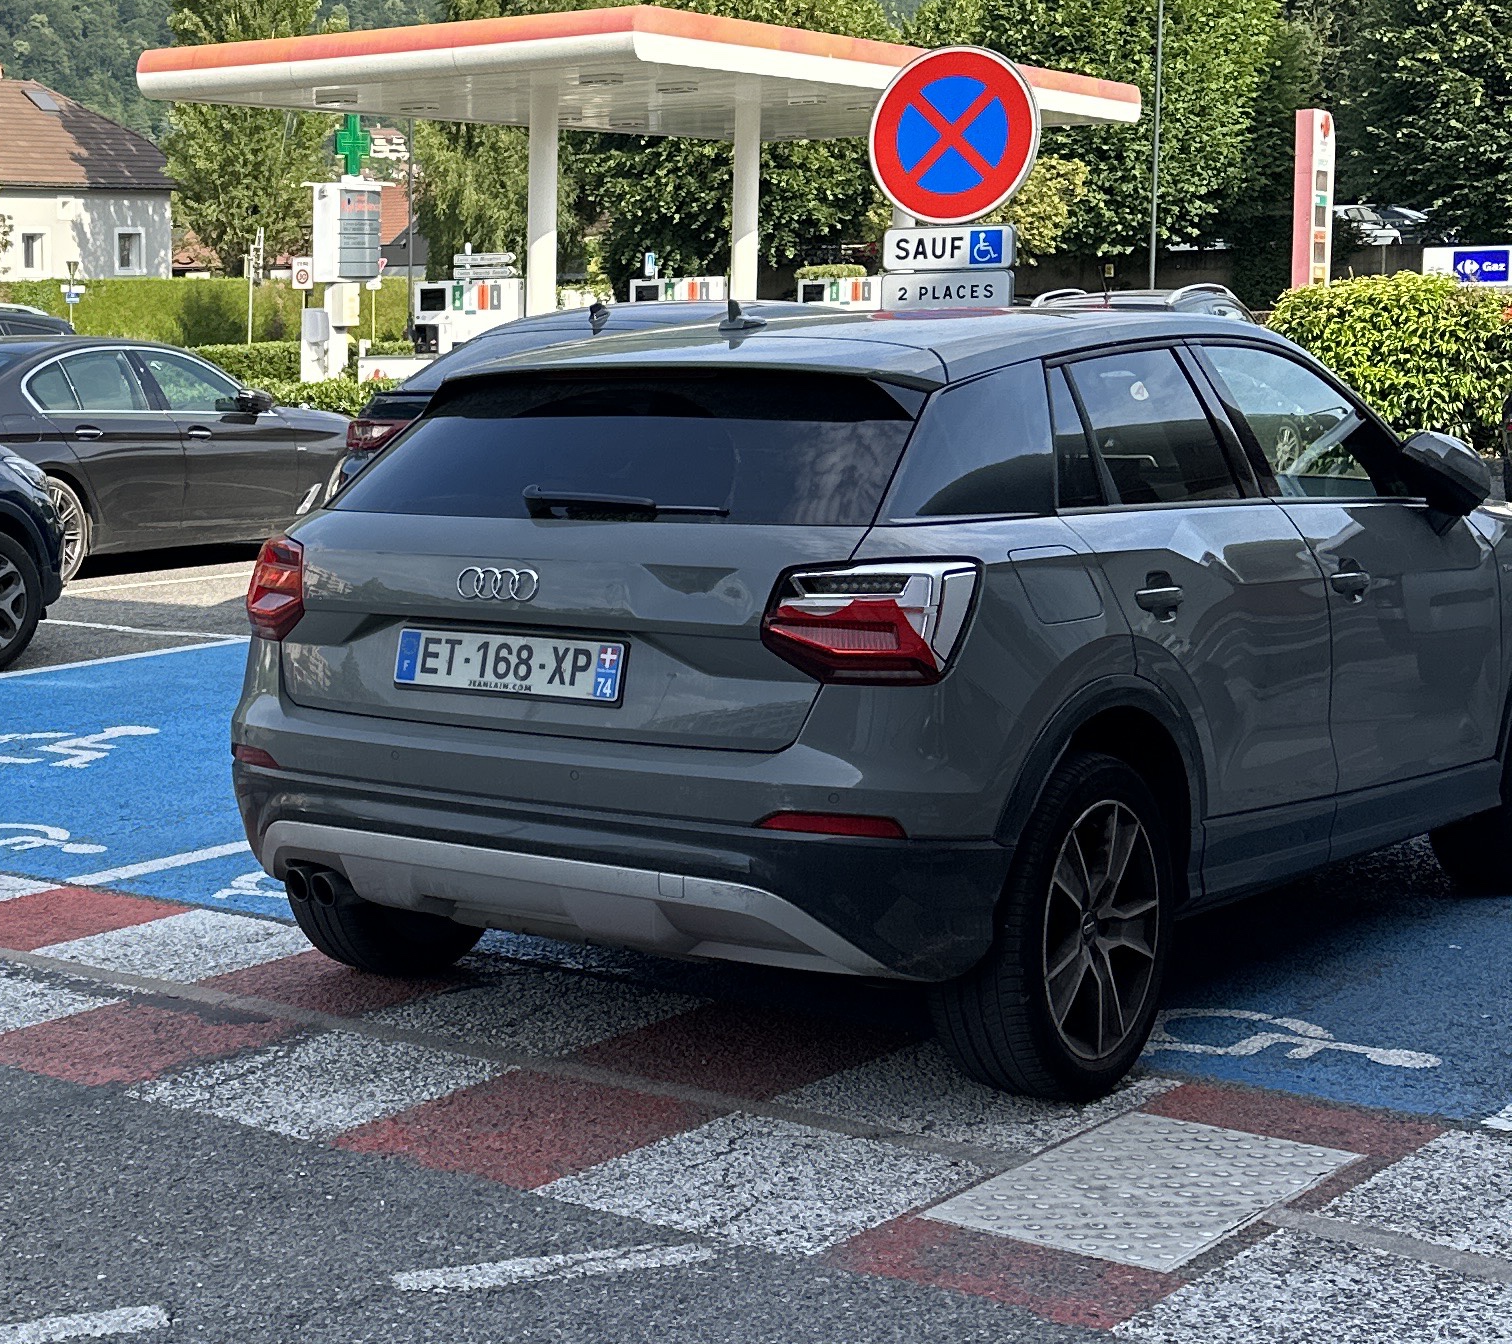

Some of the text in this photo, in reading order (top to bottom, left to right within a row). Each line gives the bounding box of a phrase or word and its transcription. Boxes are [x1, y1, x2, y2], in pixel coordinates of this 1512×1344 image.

[895, 236, 964, 260] SAUF
[1482, 261, 1506, 272] Gaz
[898, 284, 994, 301] 2 PLACES
[402, 659, 411, 672] F
[420, 637, 593, 686] ET-168-XP
[467, 679, 532, 692] JEANLAIN.COM
[595, 677, 612, 698] 74
